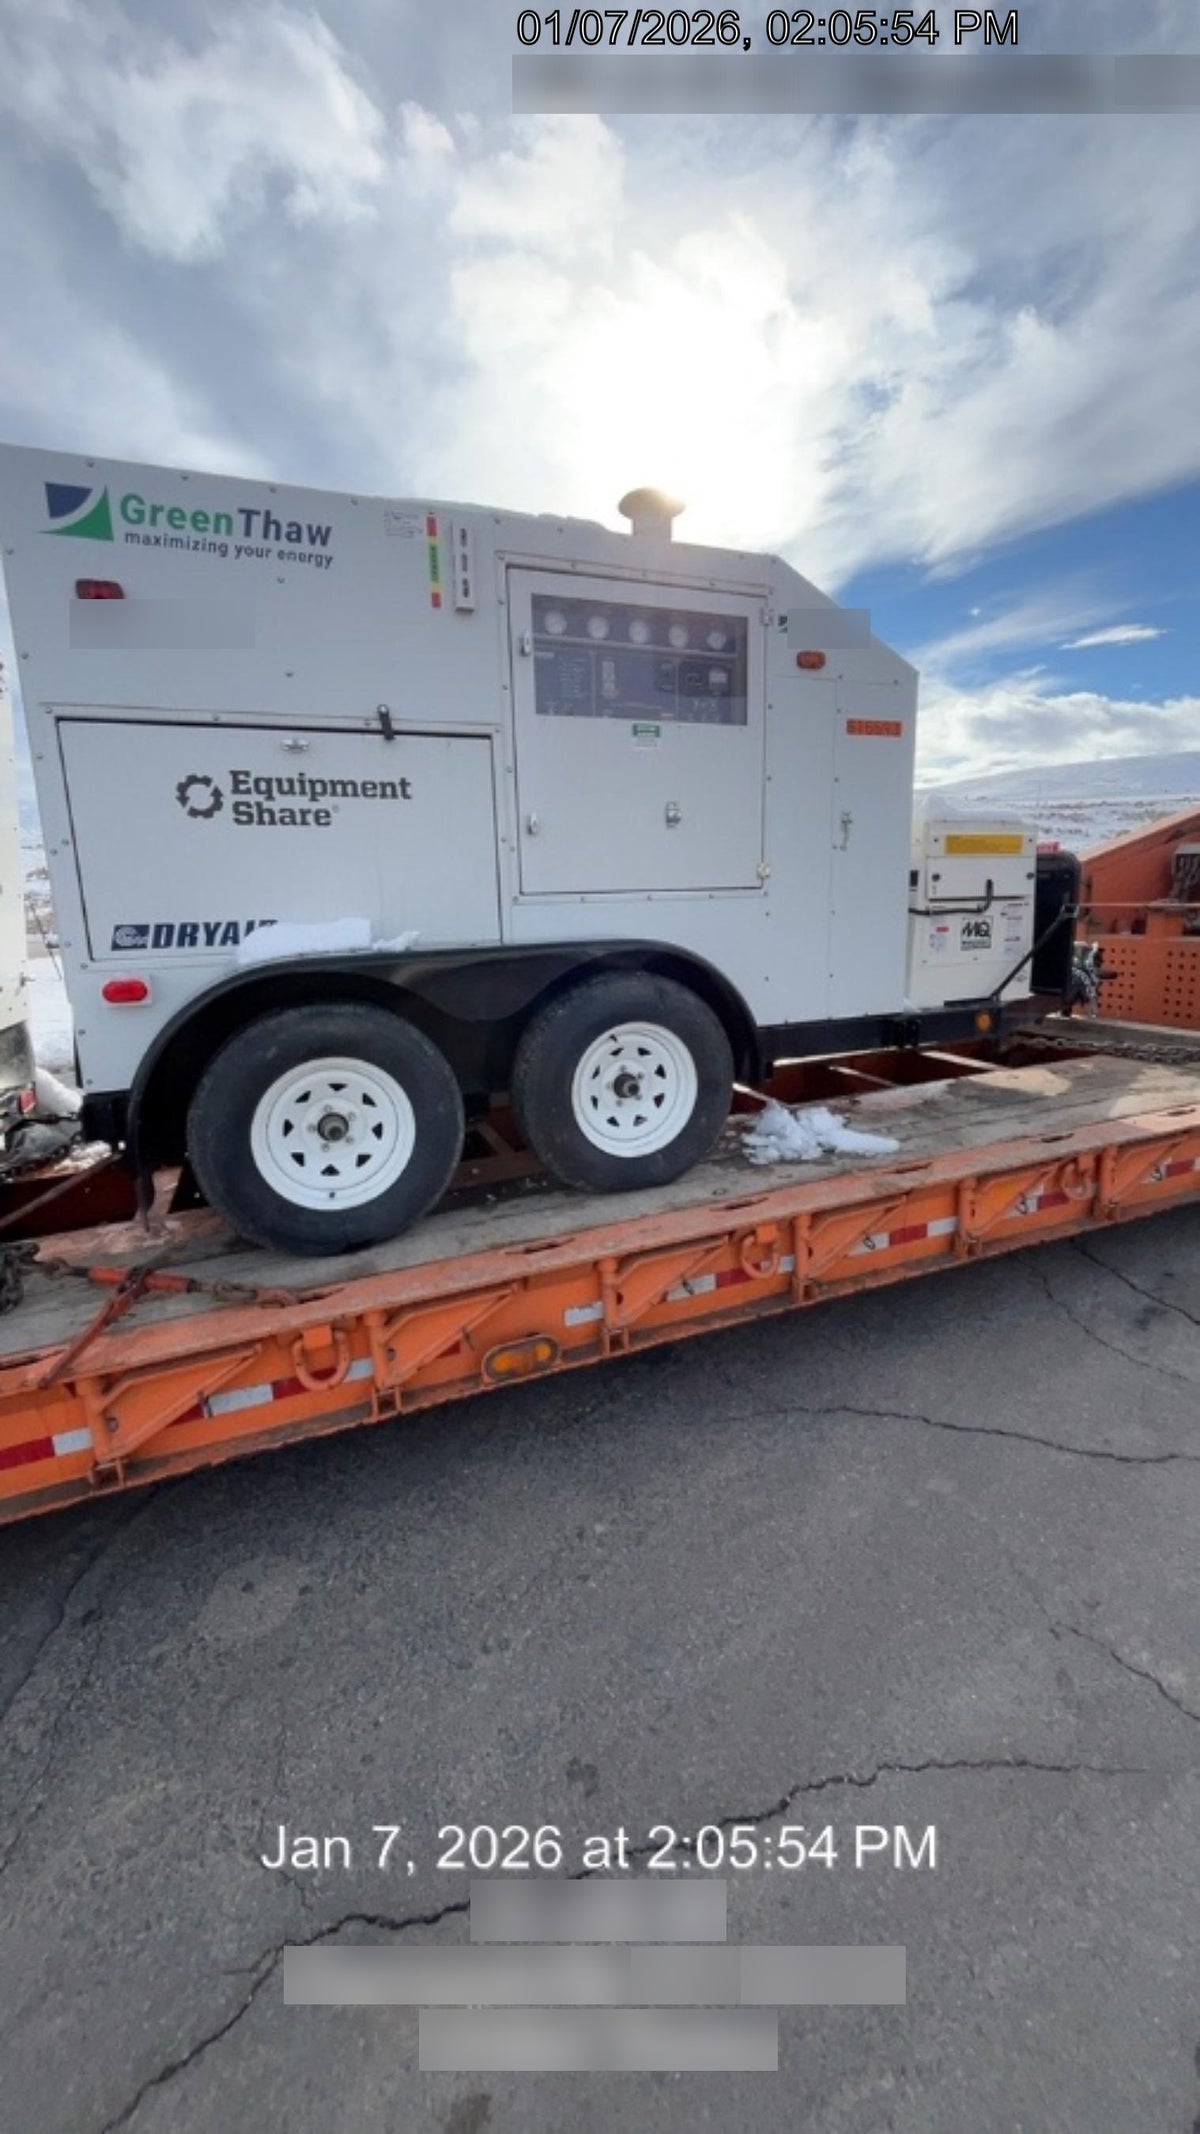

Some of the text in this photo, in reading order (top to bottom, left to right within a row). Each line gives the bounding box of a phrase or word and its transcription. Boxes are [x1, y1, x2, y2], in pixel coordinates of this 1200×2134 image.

[120, 493, 332, 547] GreenThaw
[124, 531, 333, 570] maximizing your energy
[229, 769, 412, 802] Equipment
